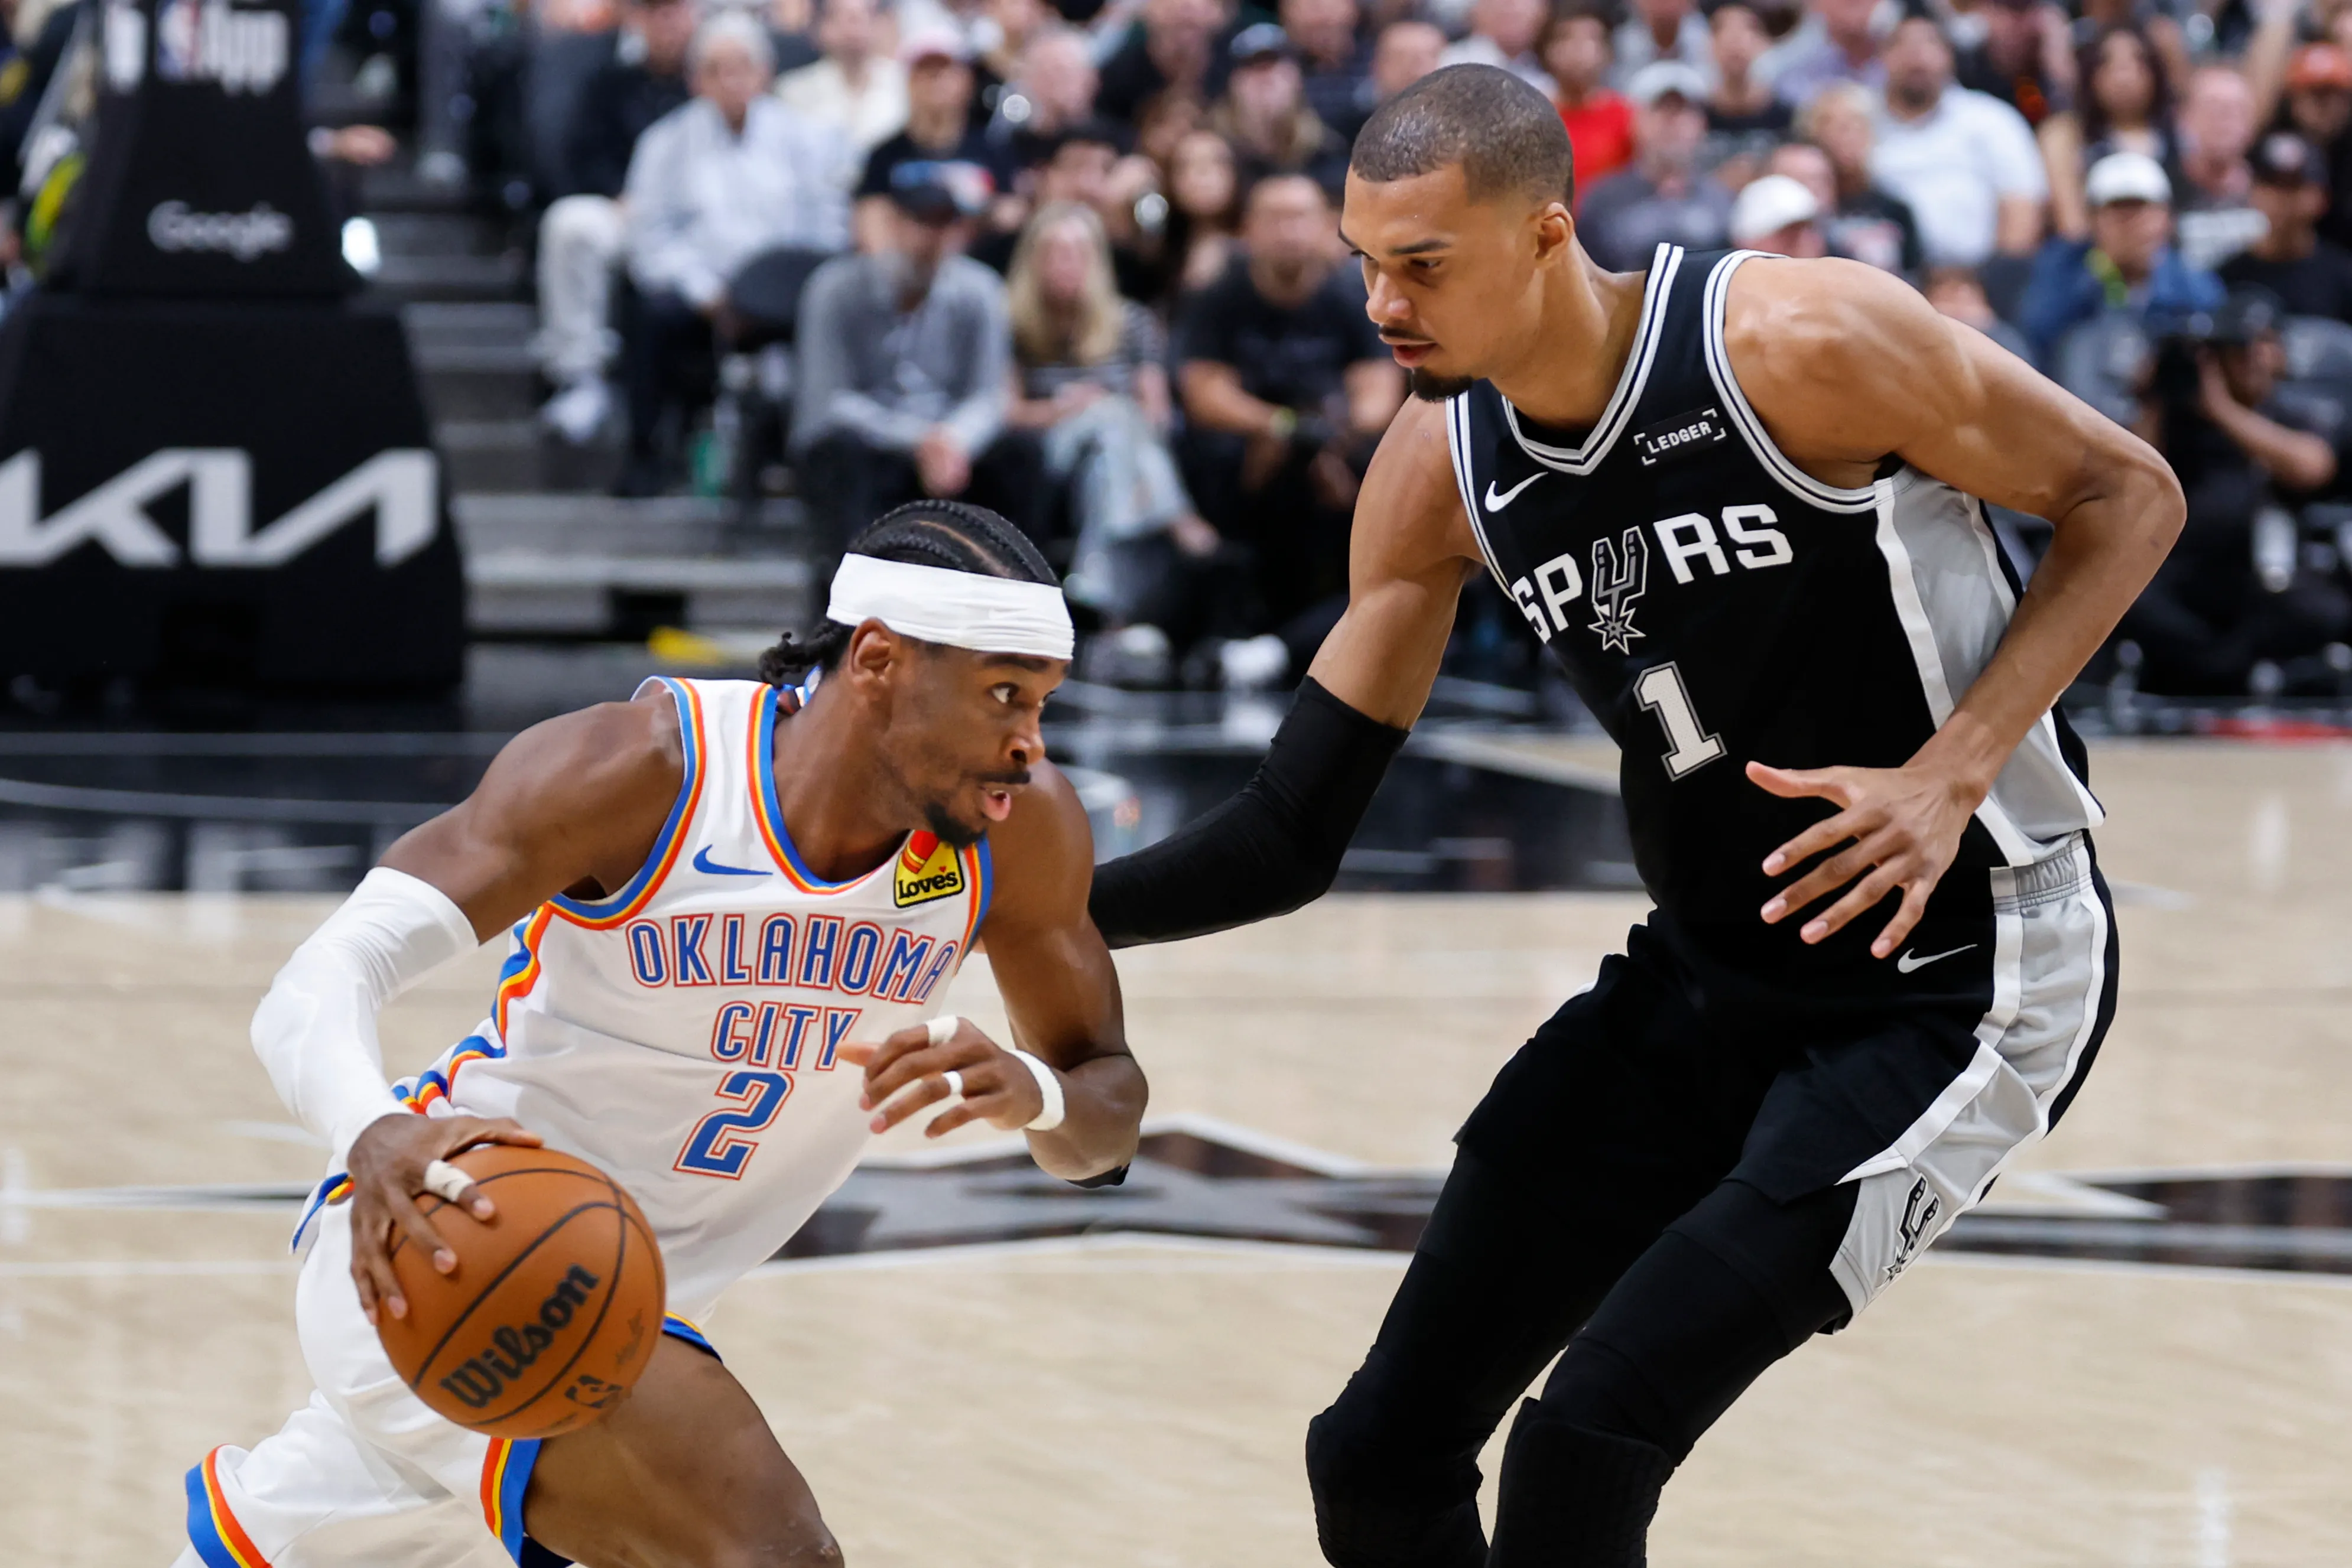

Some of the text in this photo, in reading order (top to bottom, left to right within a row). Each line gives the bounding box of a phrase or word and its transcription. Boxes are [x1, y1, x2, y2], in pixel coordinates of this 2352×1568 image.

[147, 199, 295, 263] Google
[1646, 421, 1713, 454] LEDGER
[1633, 661, 1728, 782] 1
[625, 912, 958, 1005] OKLAHOMA
[710, 1000, 862, 1071] CITY
[673, 1070, 794, 1180] 2
[439, 1262, 600, 1408] Wilson
